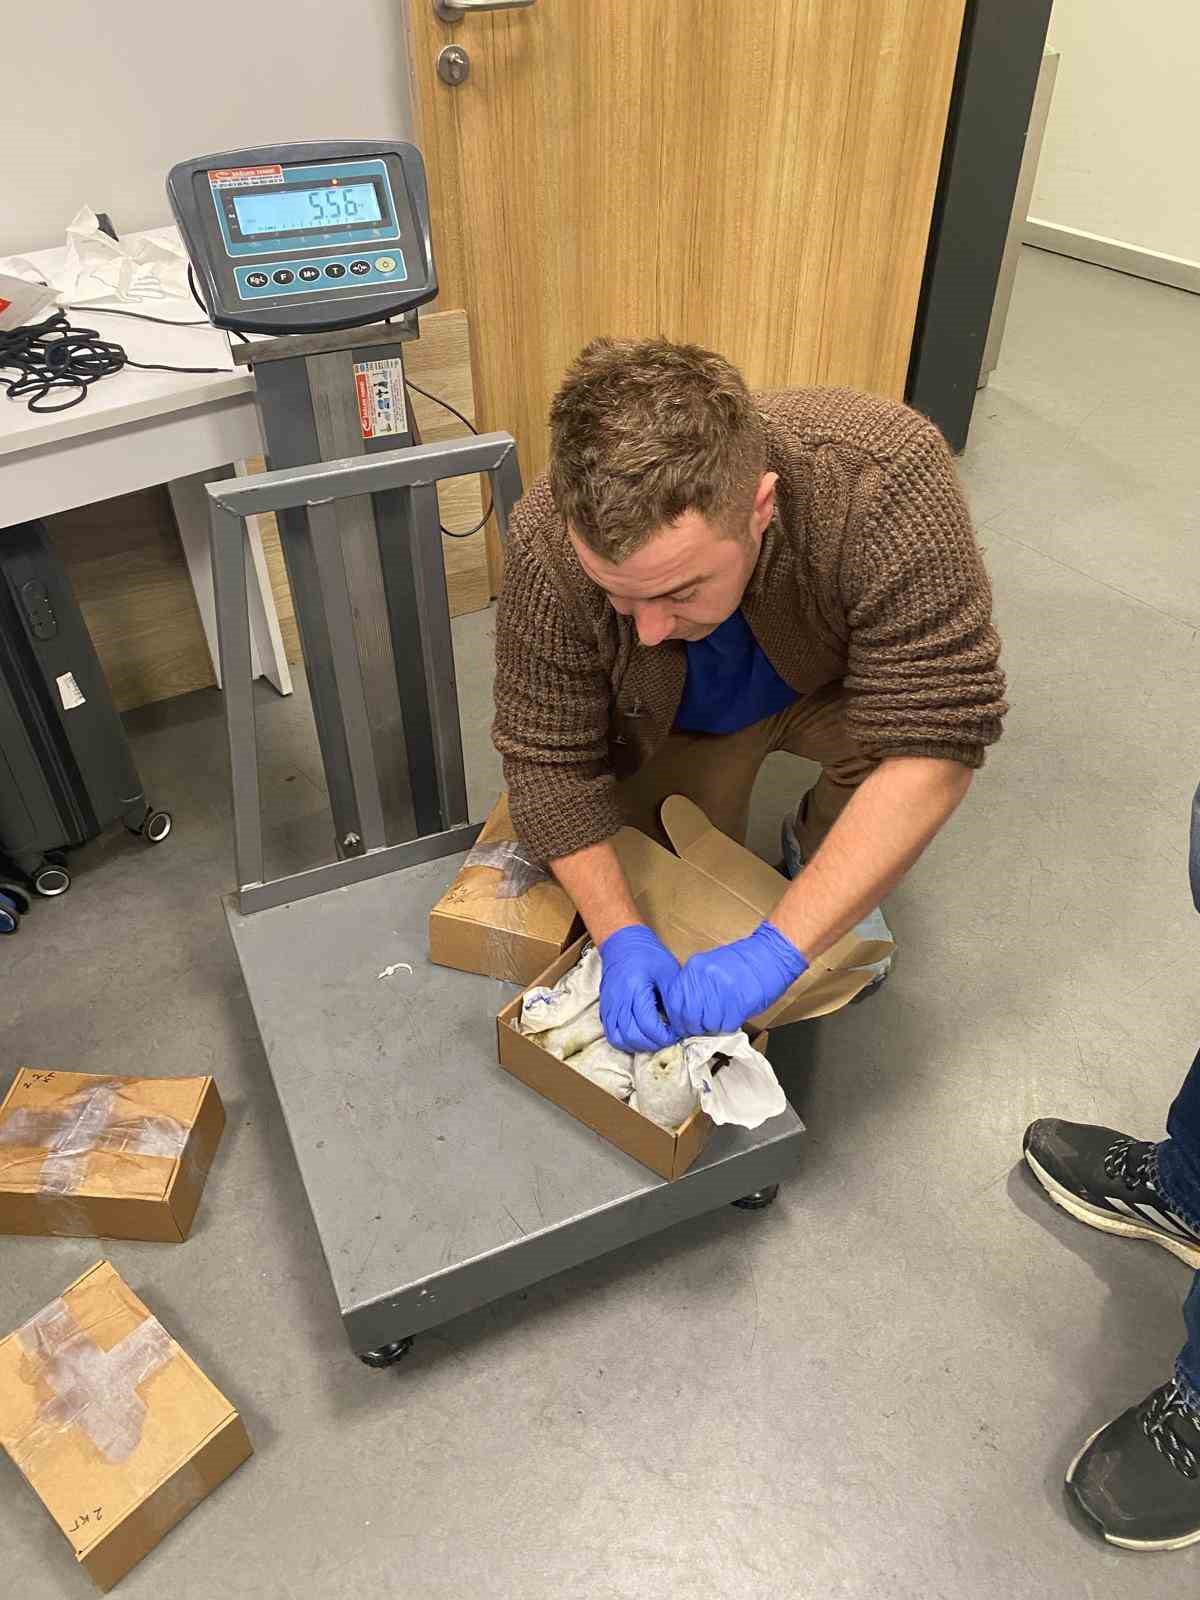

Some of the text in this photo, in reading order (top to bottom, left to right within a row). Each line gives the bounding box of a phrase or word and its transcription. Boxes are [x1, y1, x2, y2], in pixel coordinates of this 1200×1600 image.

[308, 189, 358, 220] 5.56
[280, 273, 287, 281] F
[303, 270, 316, 278] M+
[332, 267, 339, 275] T
[93, 1506, 103, 1521] 2
